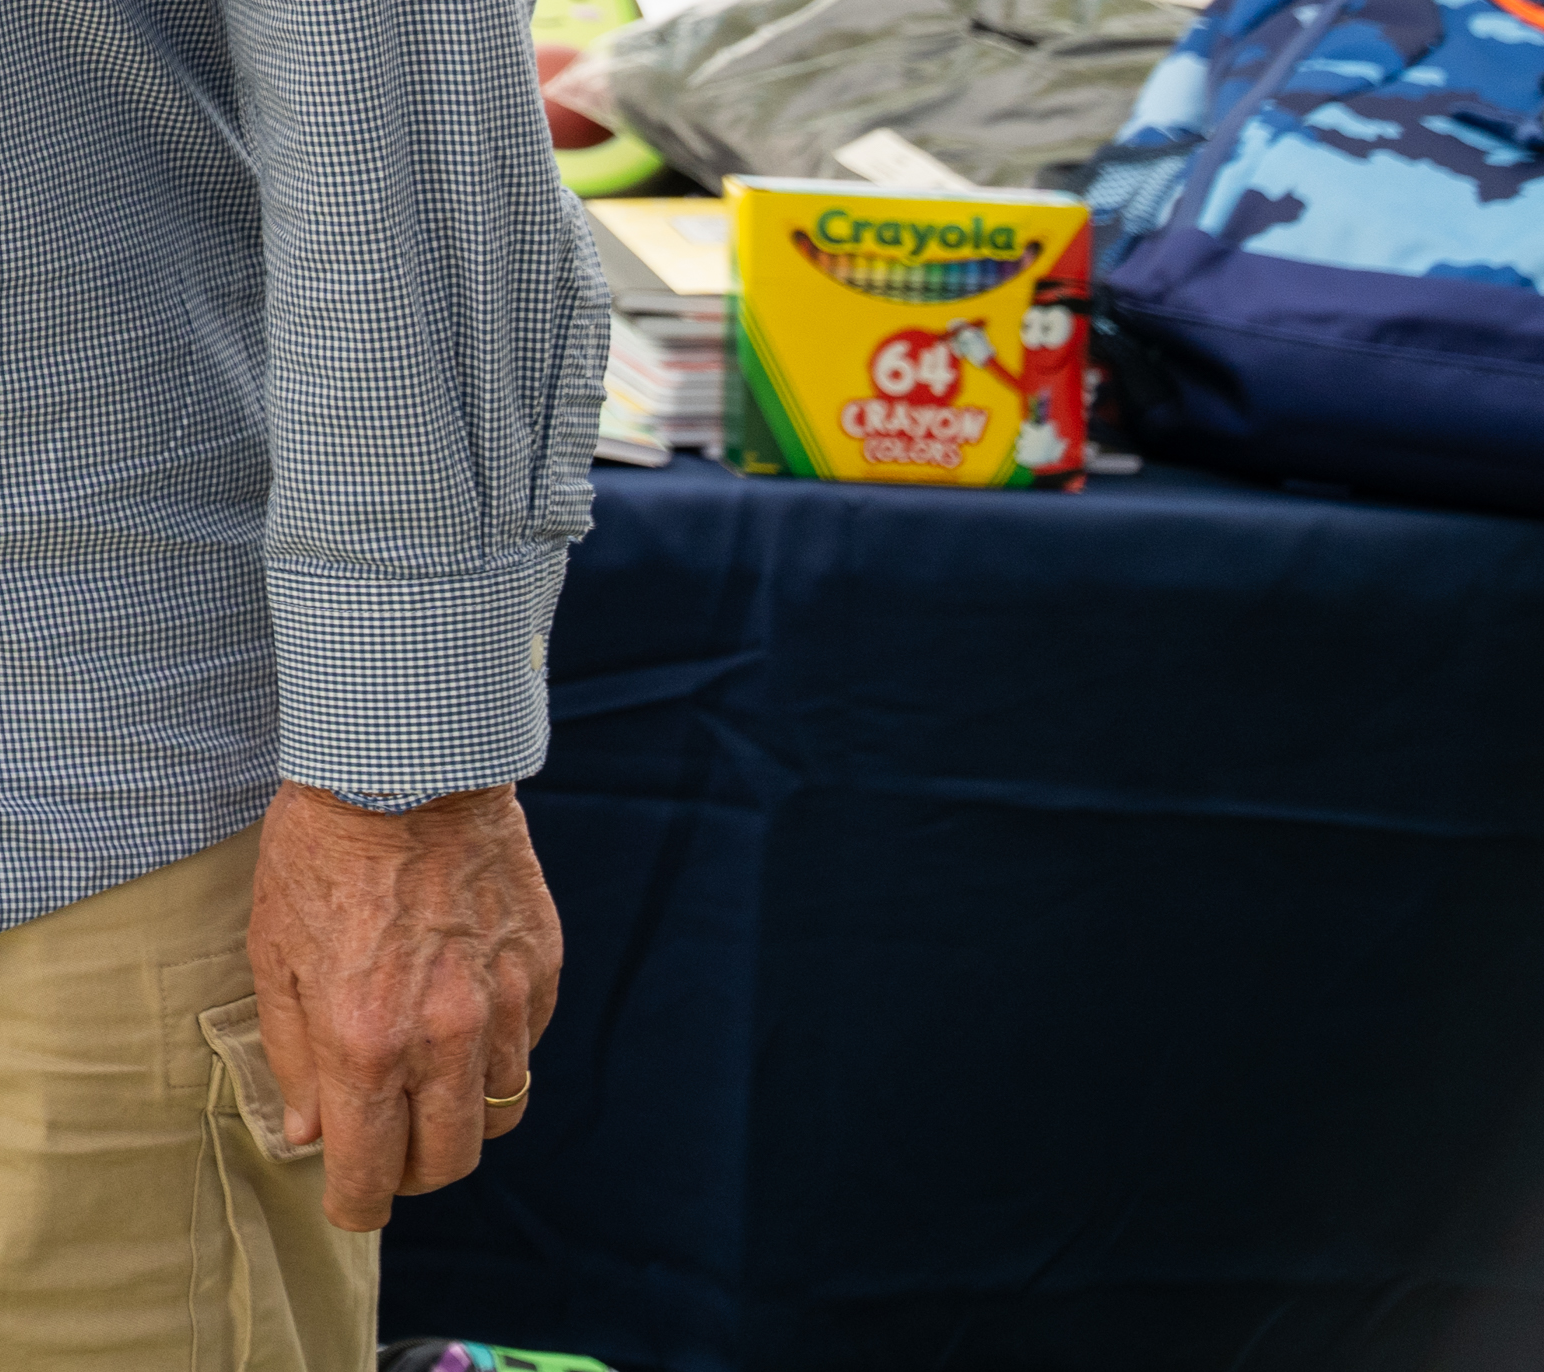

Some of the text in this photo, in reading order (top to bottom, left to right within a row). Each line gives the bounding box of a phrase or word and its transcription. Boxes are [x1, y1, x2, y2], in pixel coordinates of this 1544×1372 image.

[816, 209, 1017, 255] Crayola
[872, 340, 958, 398] 64
[840, 401, 989, 443] CRAYON
